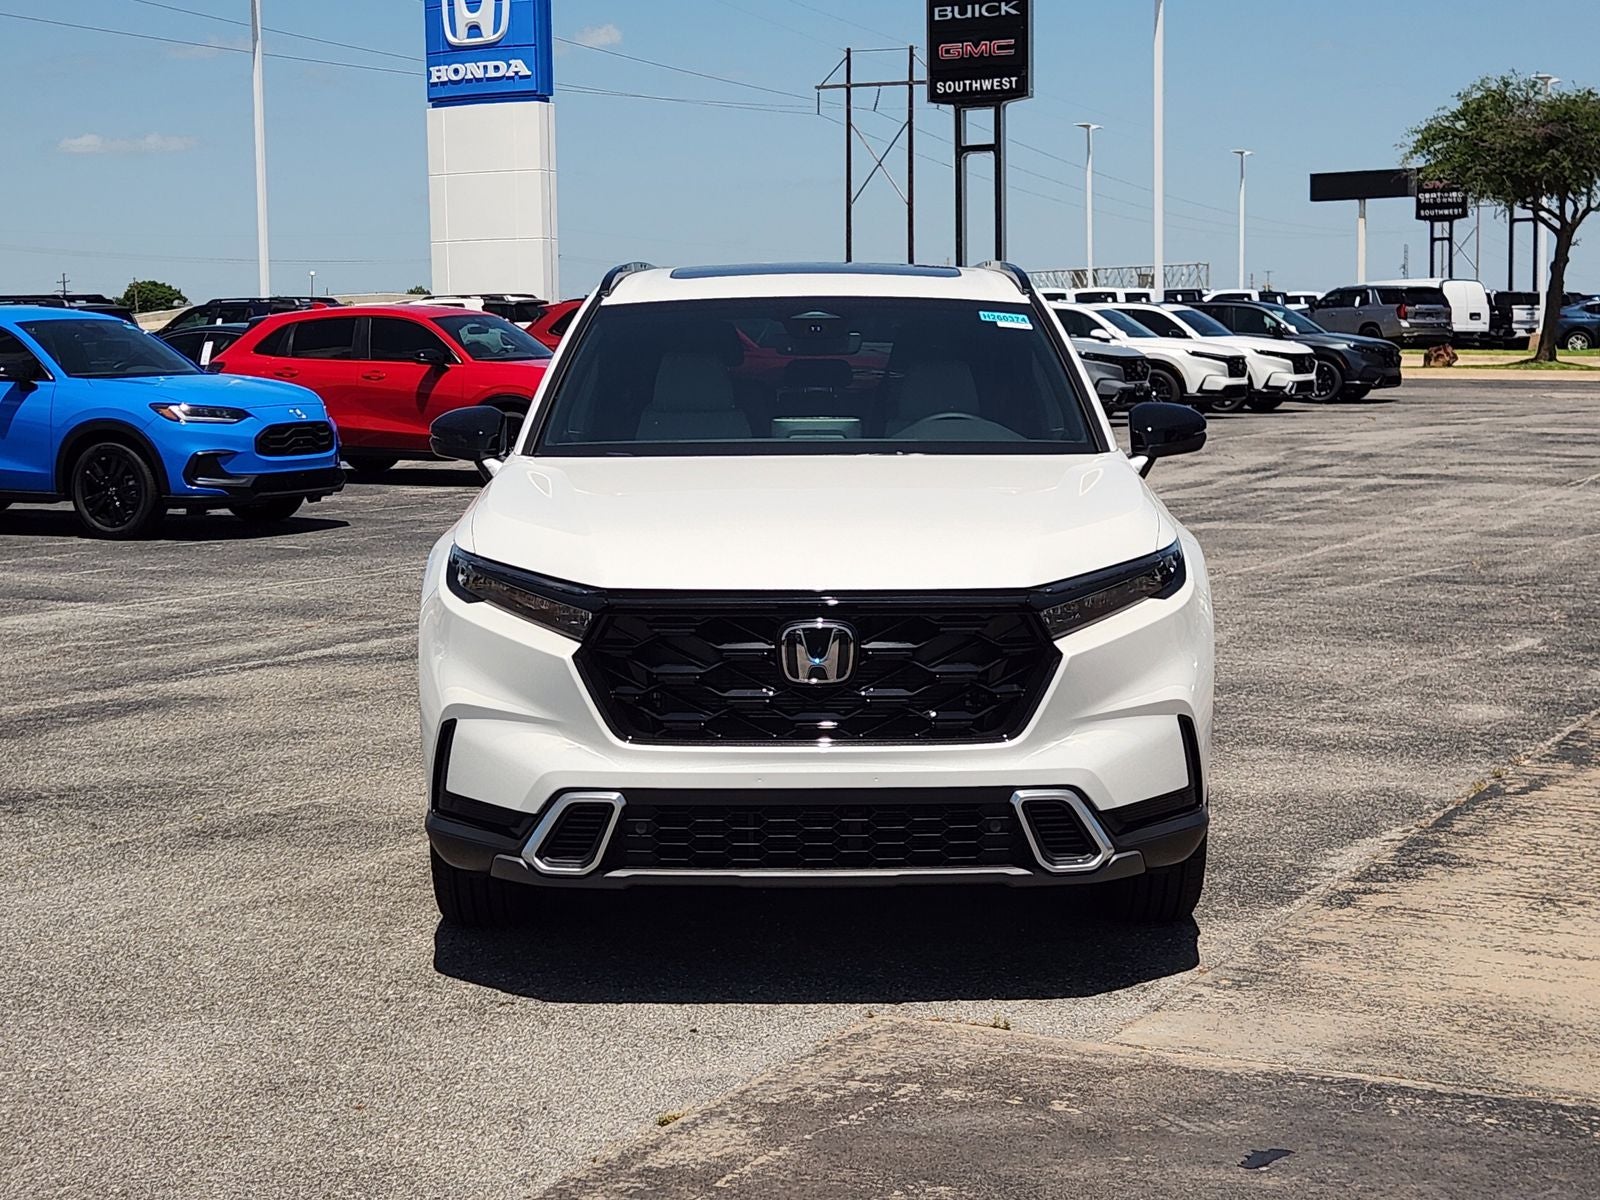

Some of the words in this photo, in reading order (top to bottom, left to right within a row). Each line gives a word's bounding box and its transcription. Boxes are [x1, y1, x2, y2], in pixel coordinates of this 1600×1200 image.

[934, 1, 1020, 20] BUICK
[939, 39, 1015, 60] GMC
[429, 59, 532, 83] HONDA
[936, 77, 1018, 94] SOUTHWEST
[1420, 208, 1463, 216] SOUTHWEST
